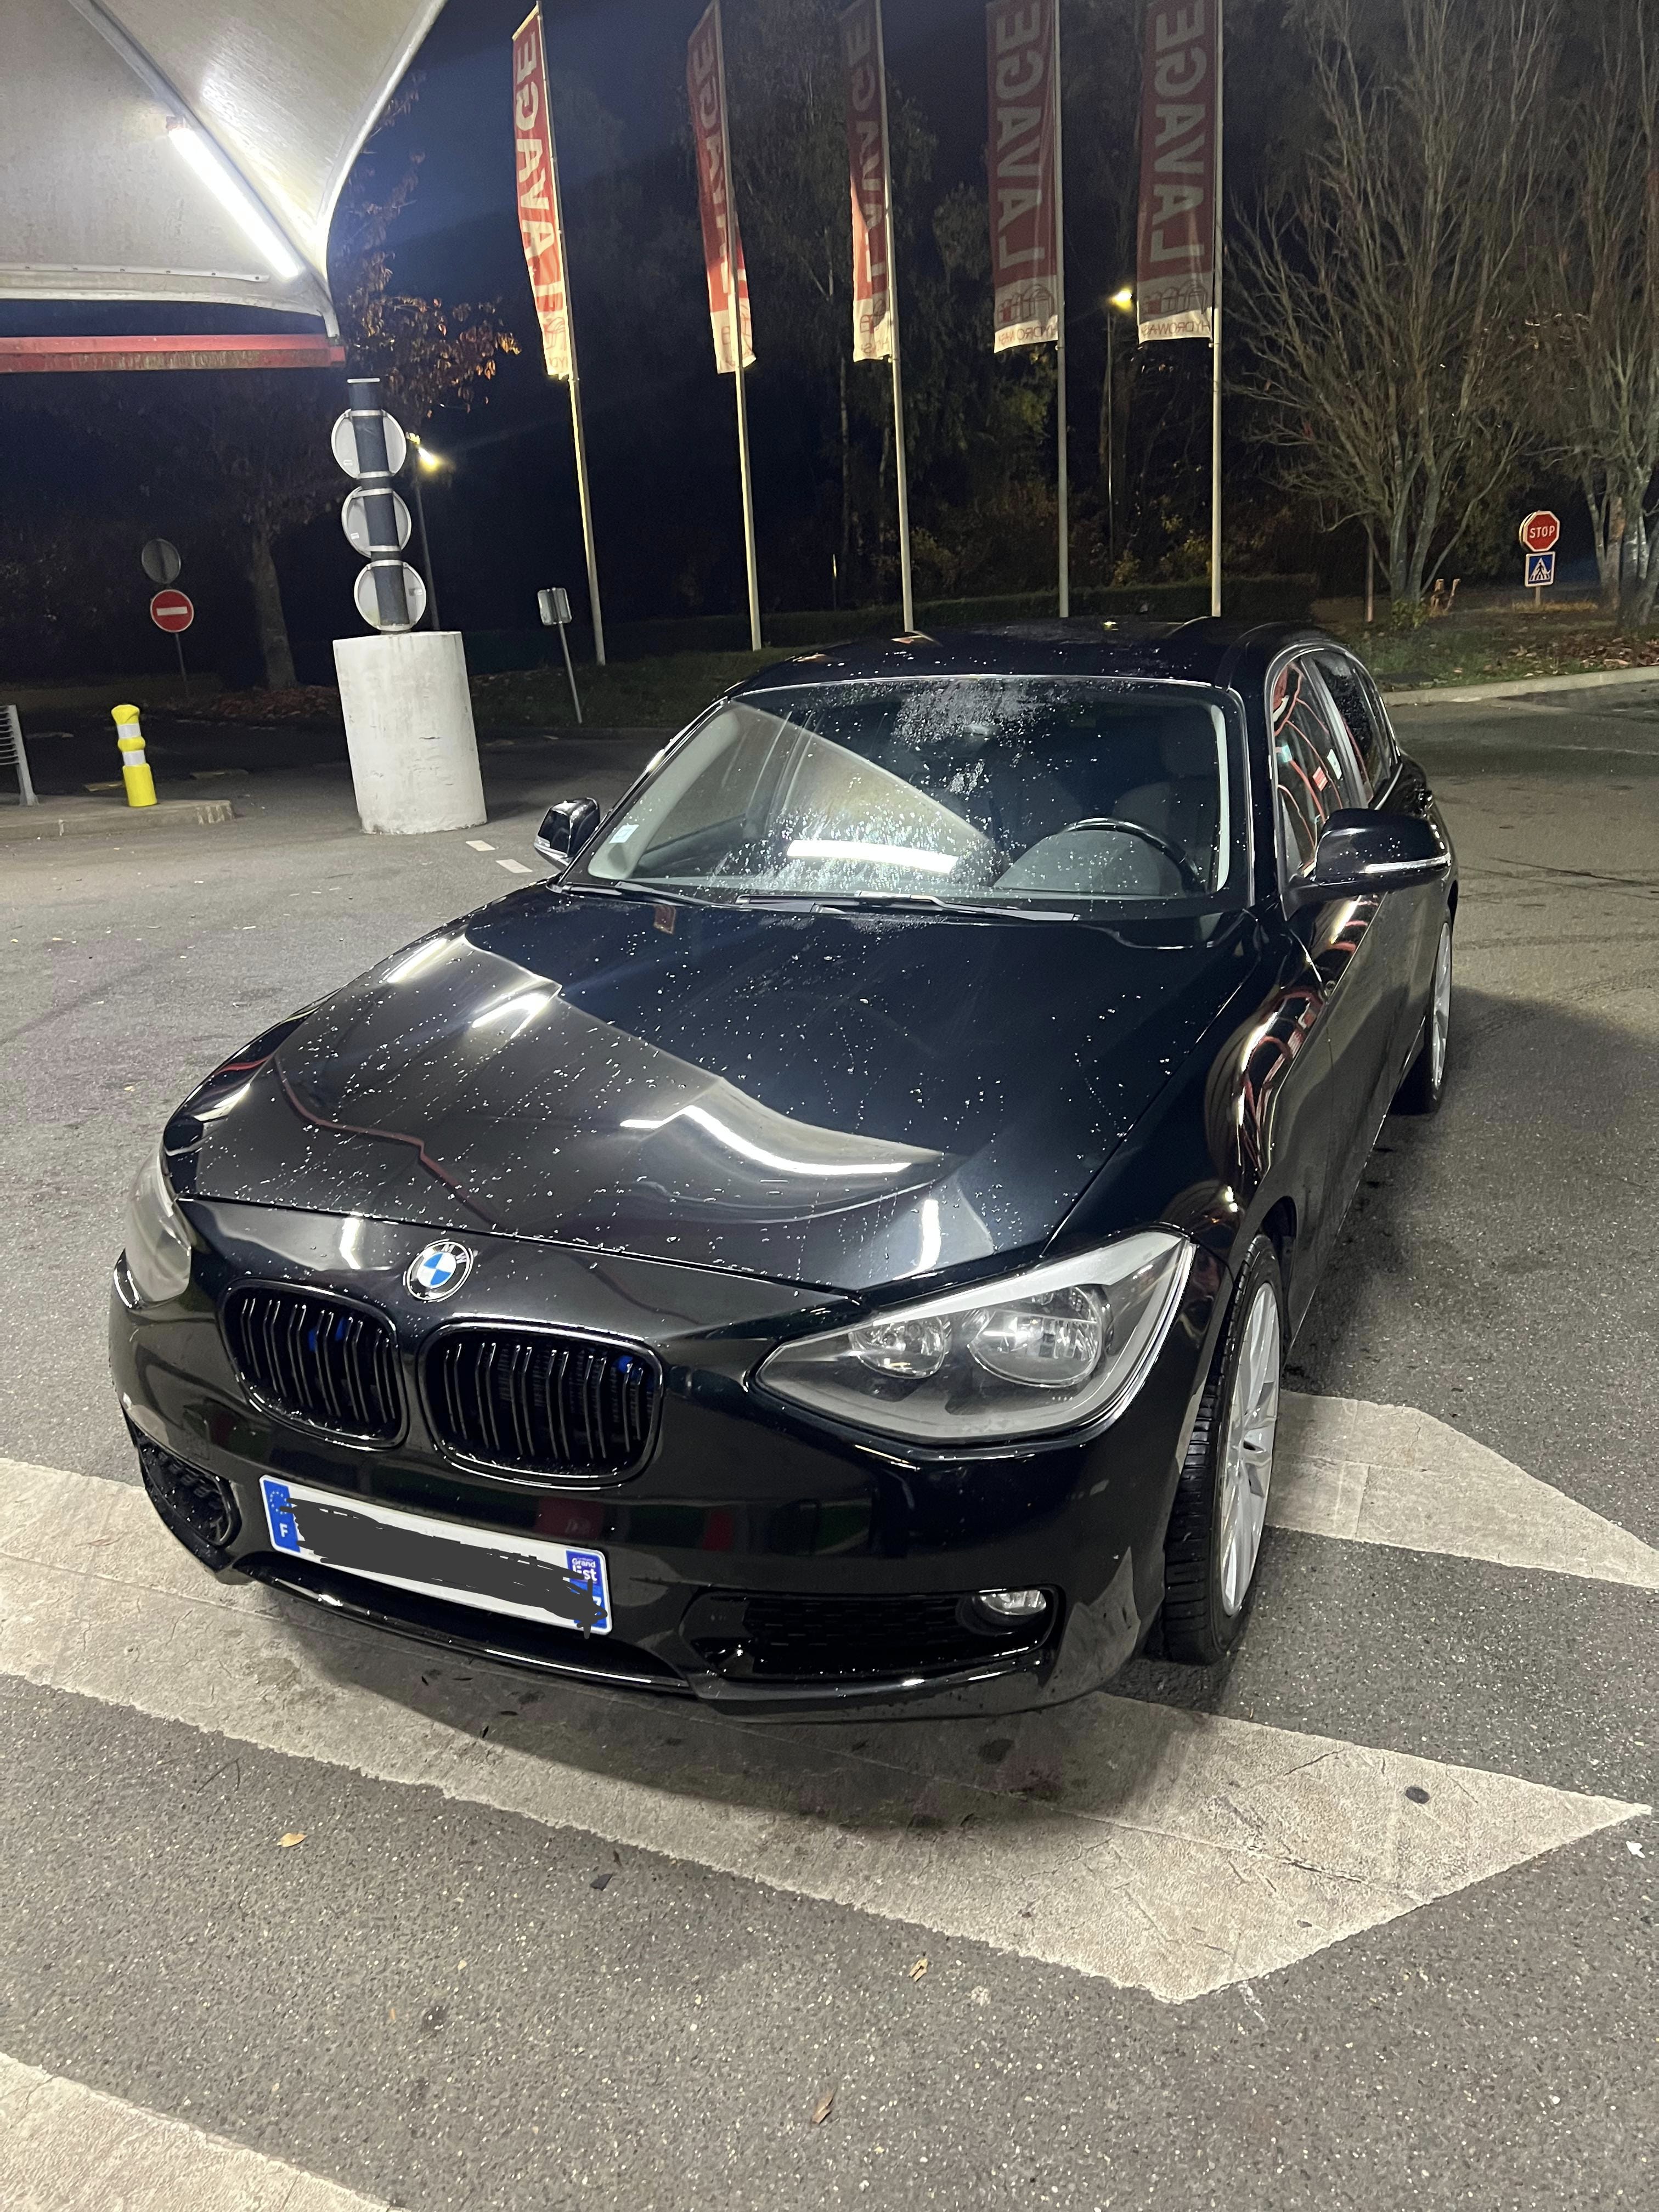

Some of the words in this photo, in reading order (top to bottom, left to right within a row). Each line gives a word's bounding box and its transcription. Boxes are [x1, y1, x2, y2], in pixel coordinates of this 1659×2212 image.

[1529, 525, 1555, 539] STOP
[280, 1522, 288, 1537] F
[572, 1558, 596, 1568] Grand
